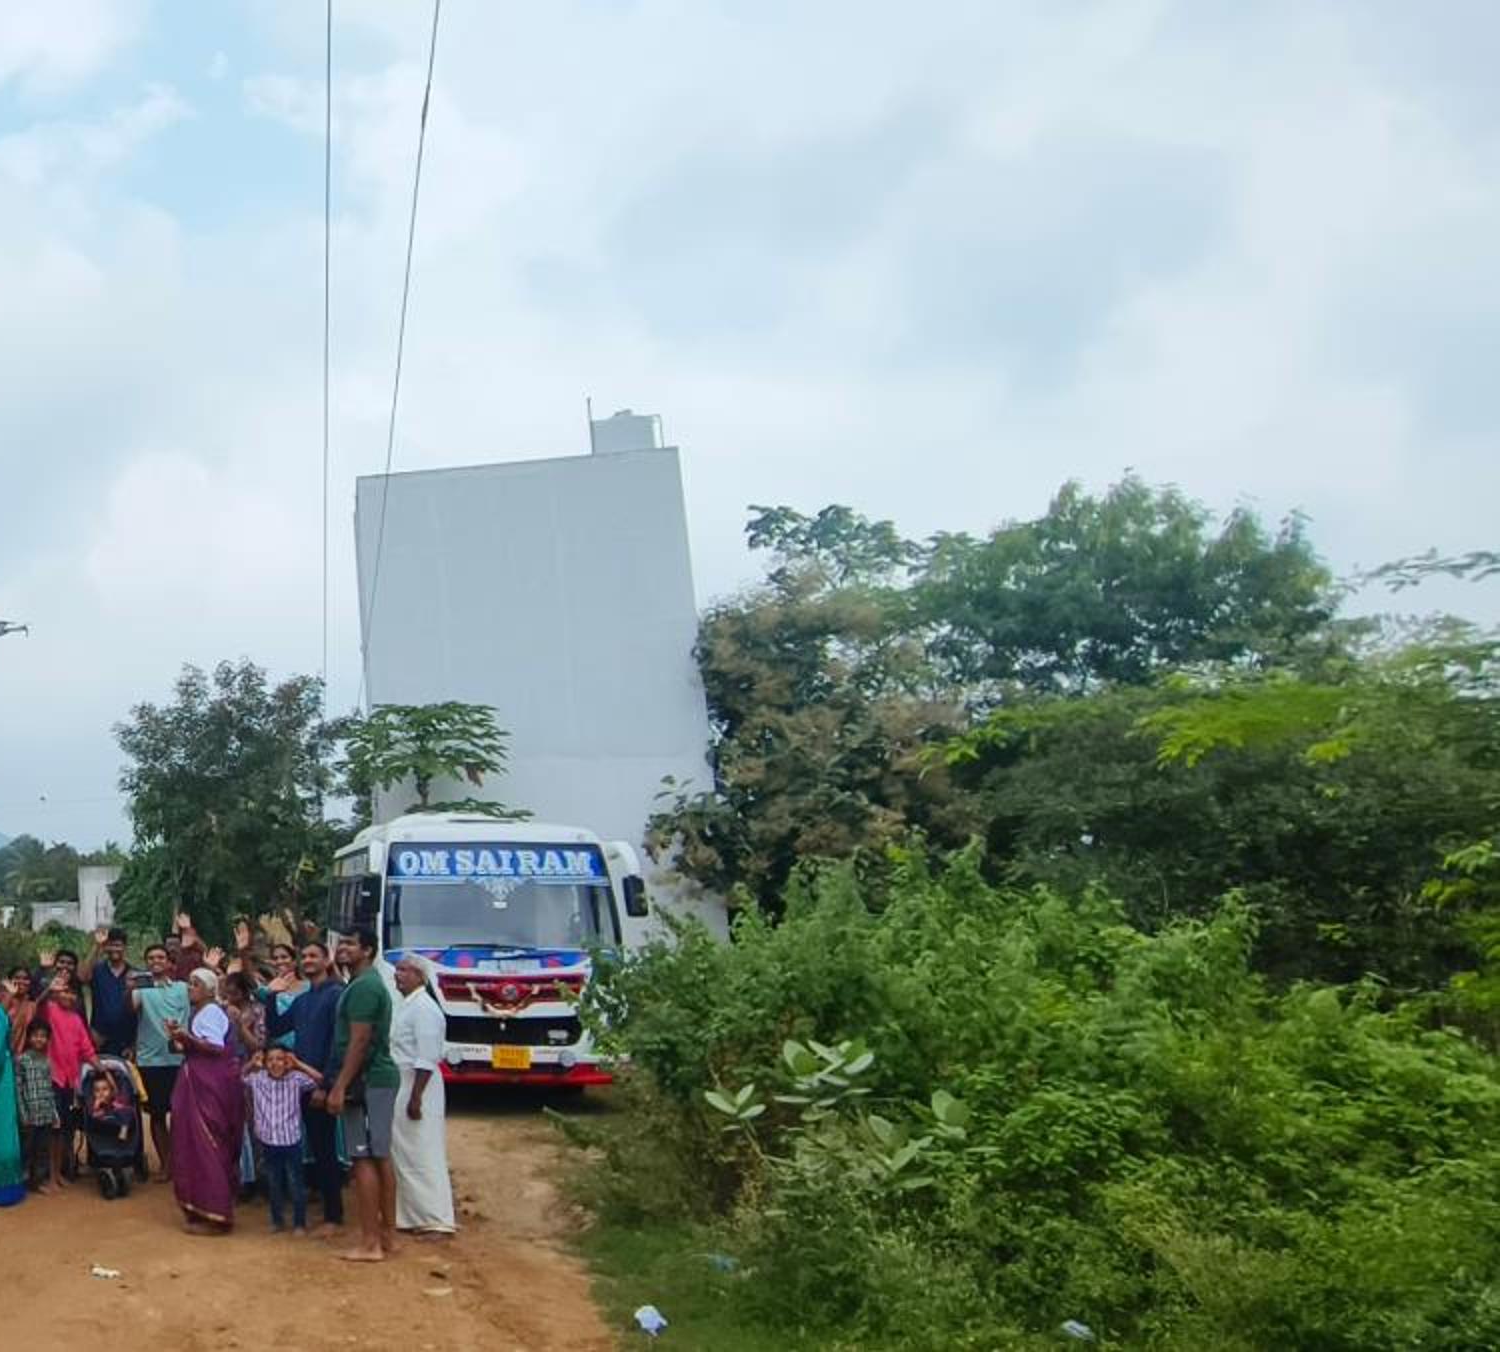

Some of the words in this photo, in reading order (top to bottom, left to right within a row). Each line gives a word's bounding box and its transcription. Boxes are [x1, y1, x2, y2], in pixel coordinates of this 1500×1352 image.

[398, 850, 450, 876] OM
[455, 849, 514, 875] SAI
[517, 850, 593, 876] RAM
